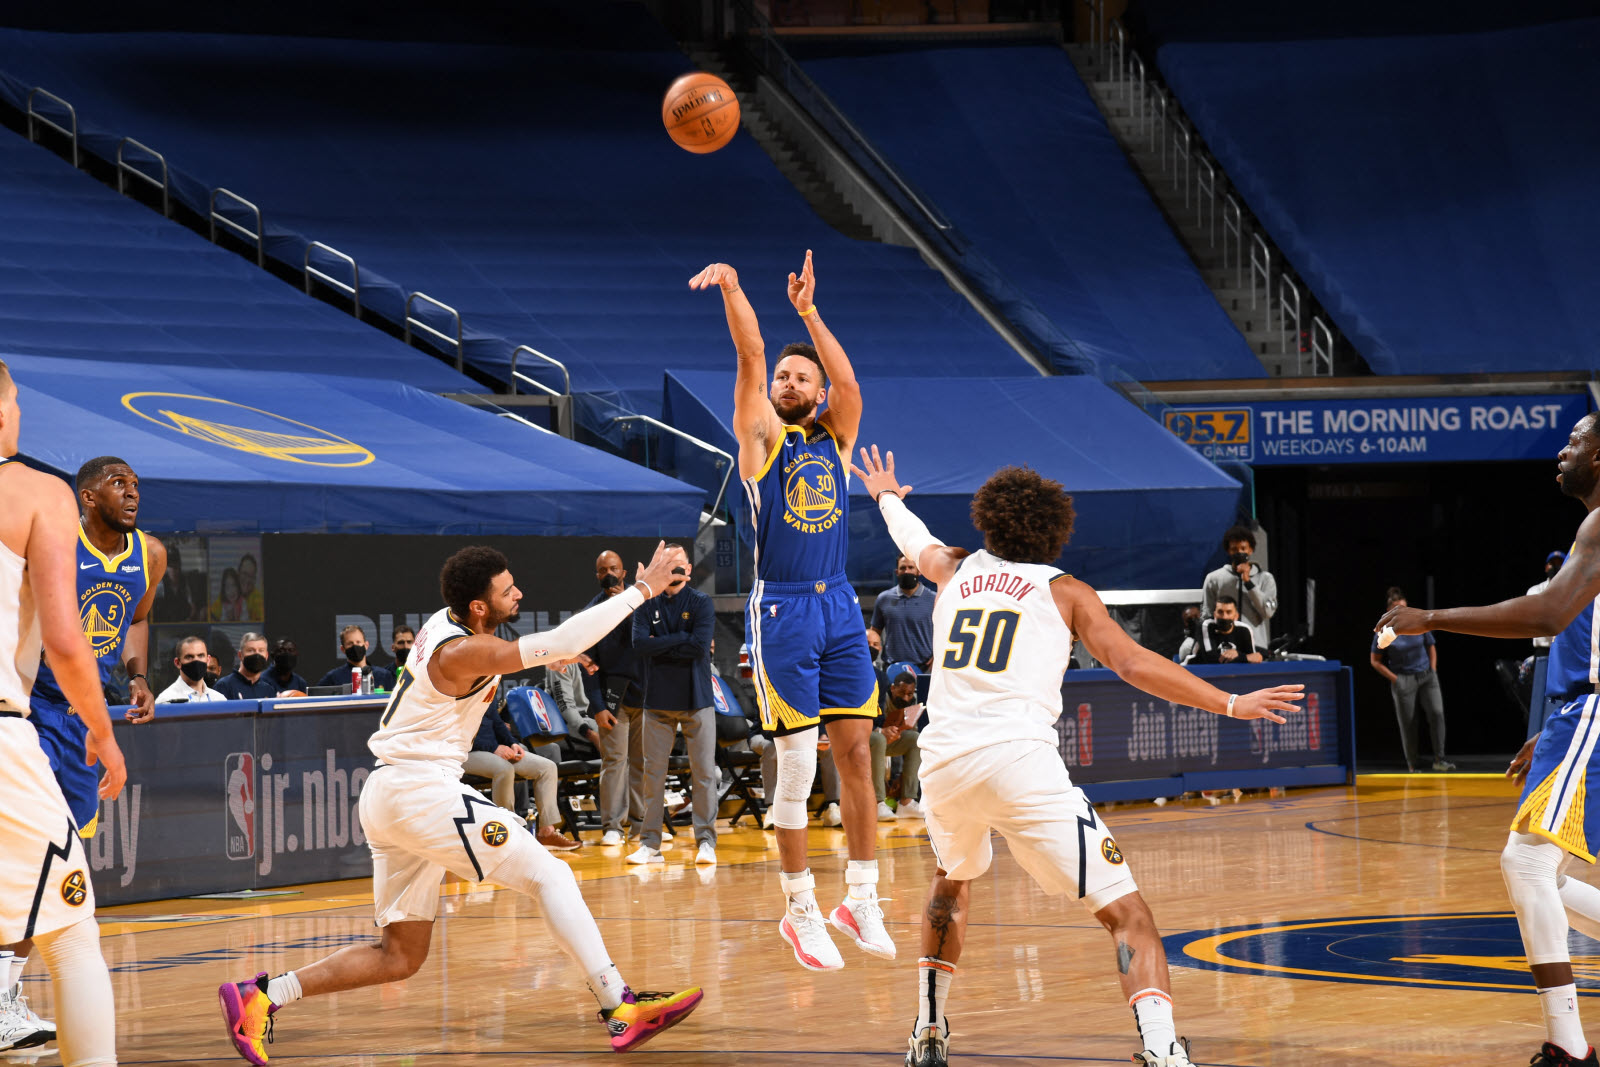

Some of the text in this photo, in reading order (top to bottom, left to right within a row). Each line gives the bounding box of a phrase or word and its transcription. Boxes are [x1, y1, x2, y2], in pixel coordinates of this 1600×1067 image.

[1169, 413, 1245, 442] 95.7
[1260, 404, 1562, 435] THE MORNING ROAST
[1261, 436, 1427, 456] WEEKDAYS 6-10AM
[816, 474, 832, 492] 30
[783, 507, 843, 533] WARRIORS
[80, 581, 132, 603] GOLDEN STATE
[959, 572, 1035, 601] GORDON
[107, 604, 118, 621] 5
[93, 636, 122, 659] RIORS
[941, 607, 1022, 674] 50
[230, 834, 245, 853] NBA
